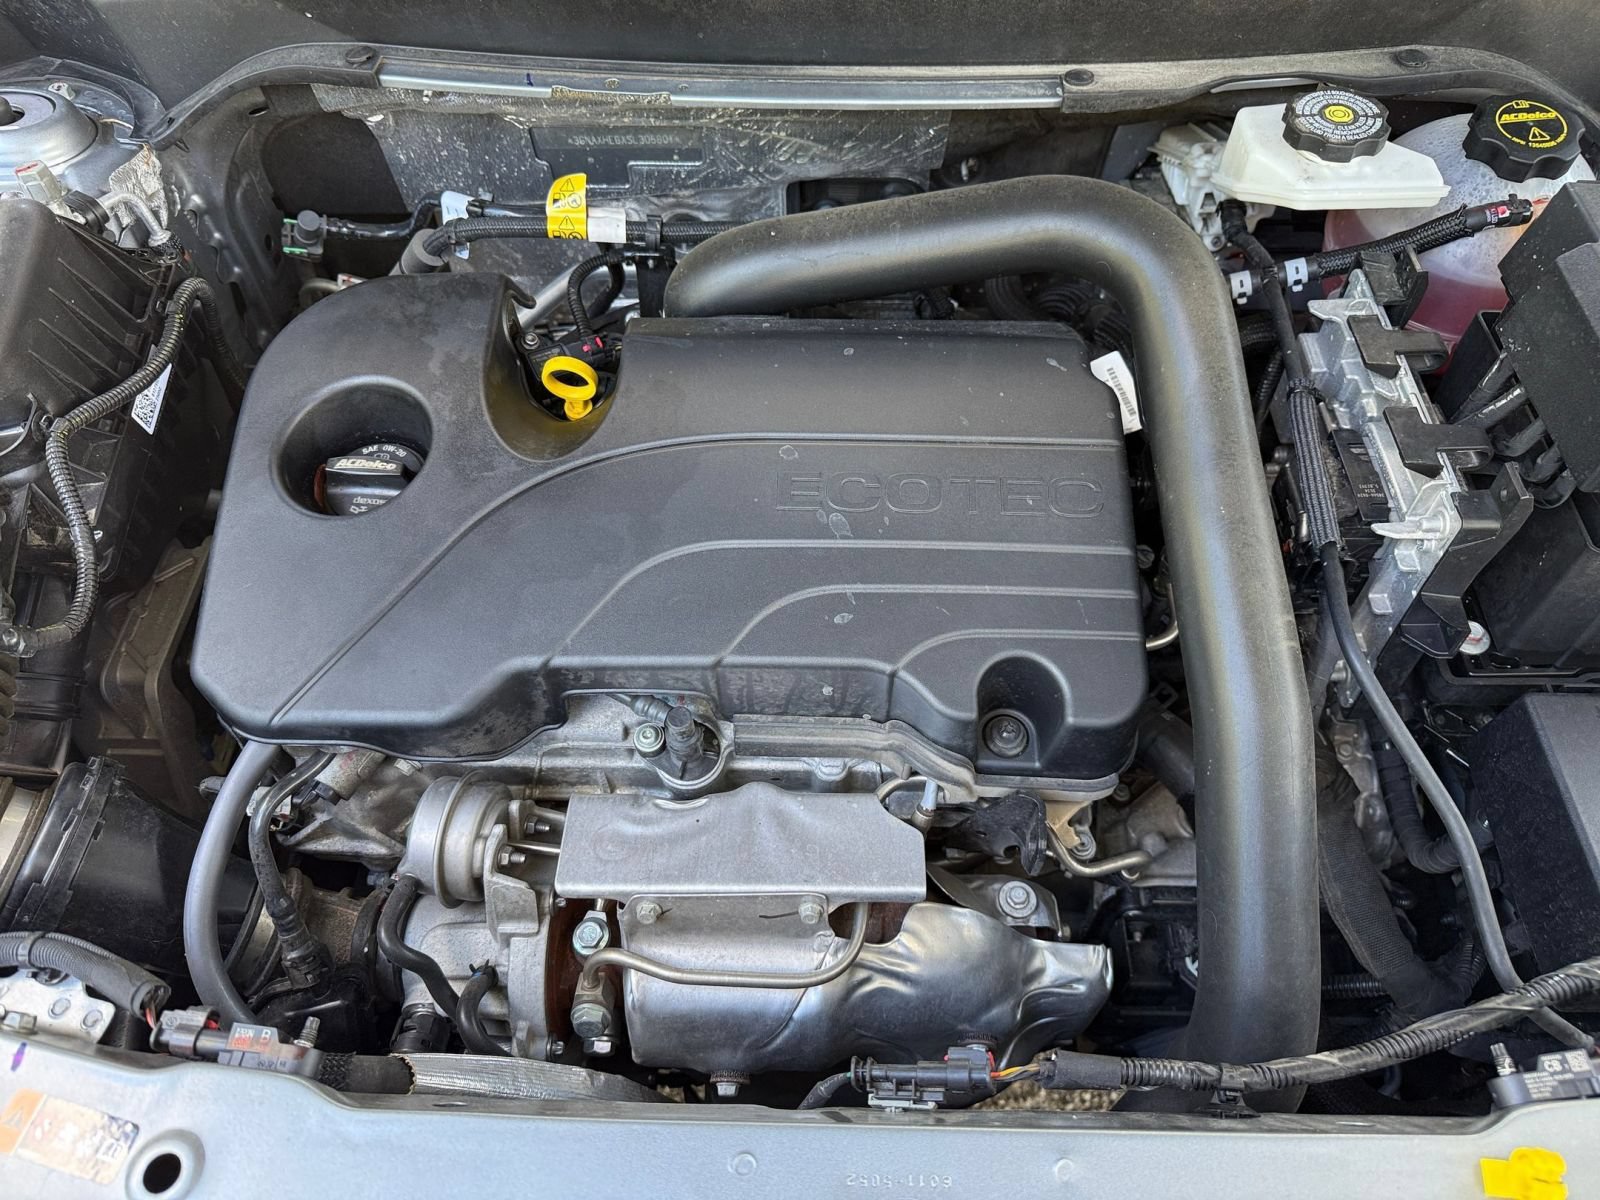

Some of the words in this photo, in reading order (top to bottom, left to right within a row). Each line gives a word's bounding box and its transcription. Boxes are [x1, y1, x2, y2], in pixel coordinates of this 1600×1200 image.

[1500, 111, 1557, 121] ACDelco
[362, 444, 379, 455] SAE
[382, 444, 407, 458] 0W-20
[334, 459, 397, 471] ACDelco
[775, 471, 1104, 518] ECOTEC
